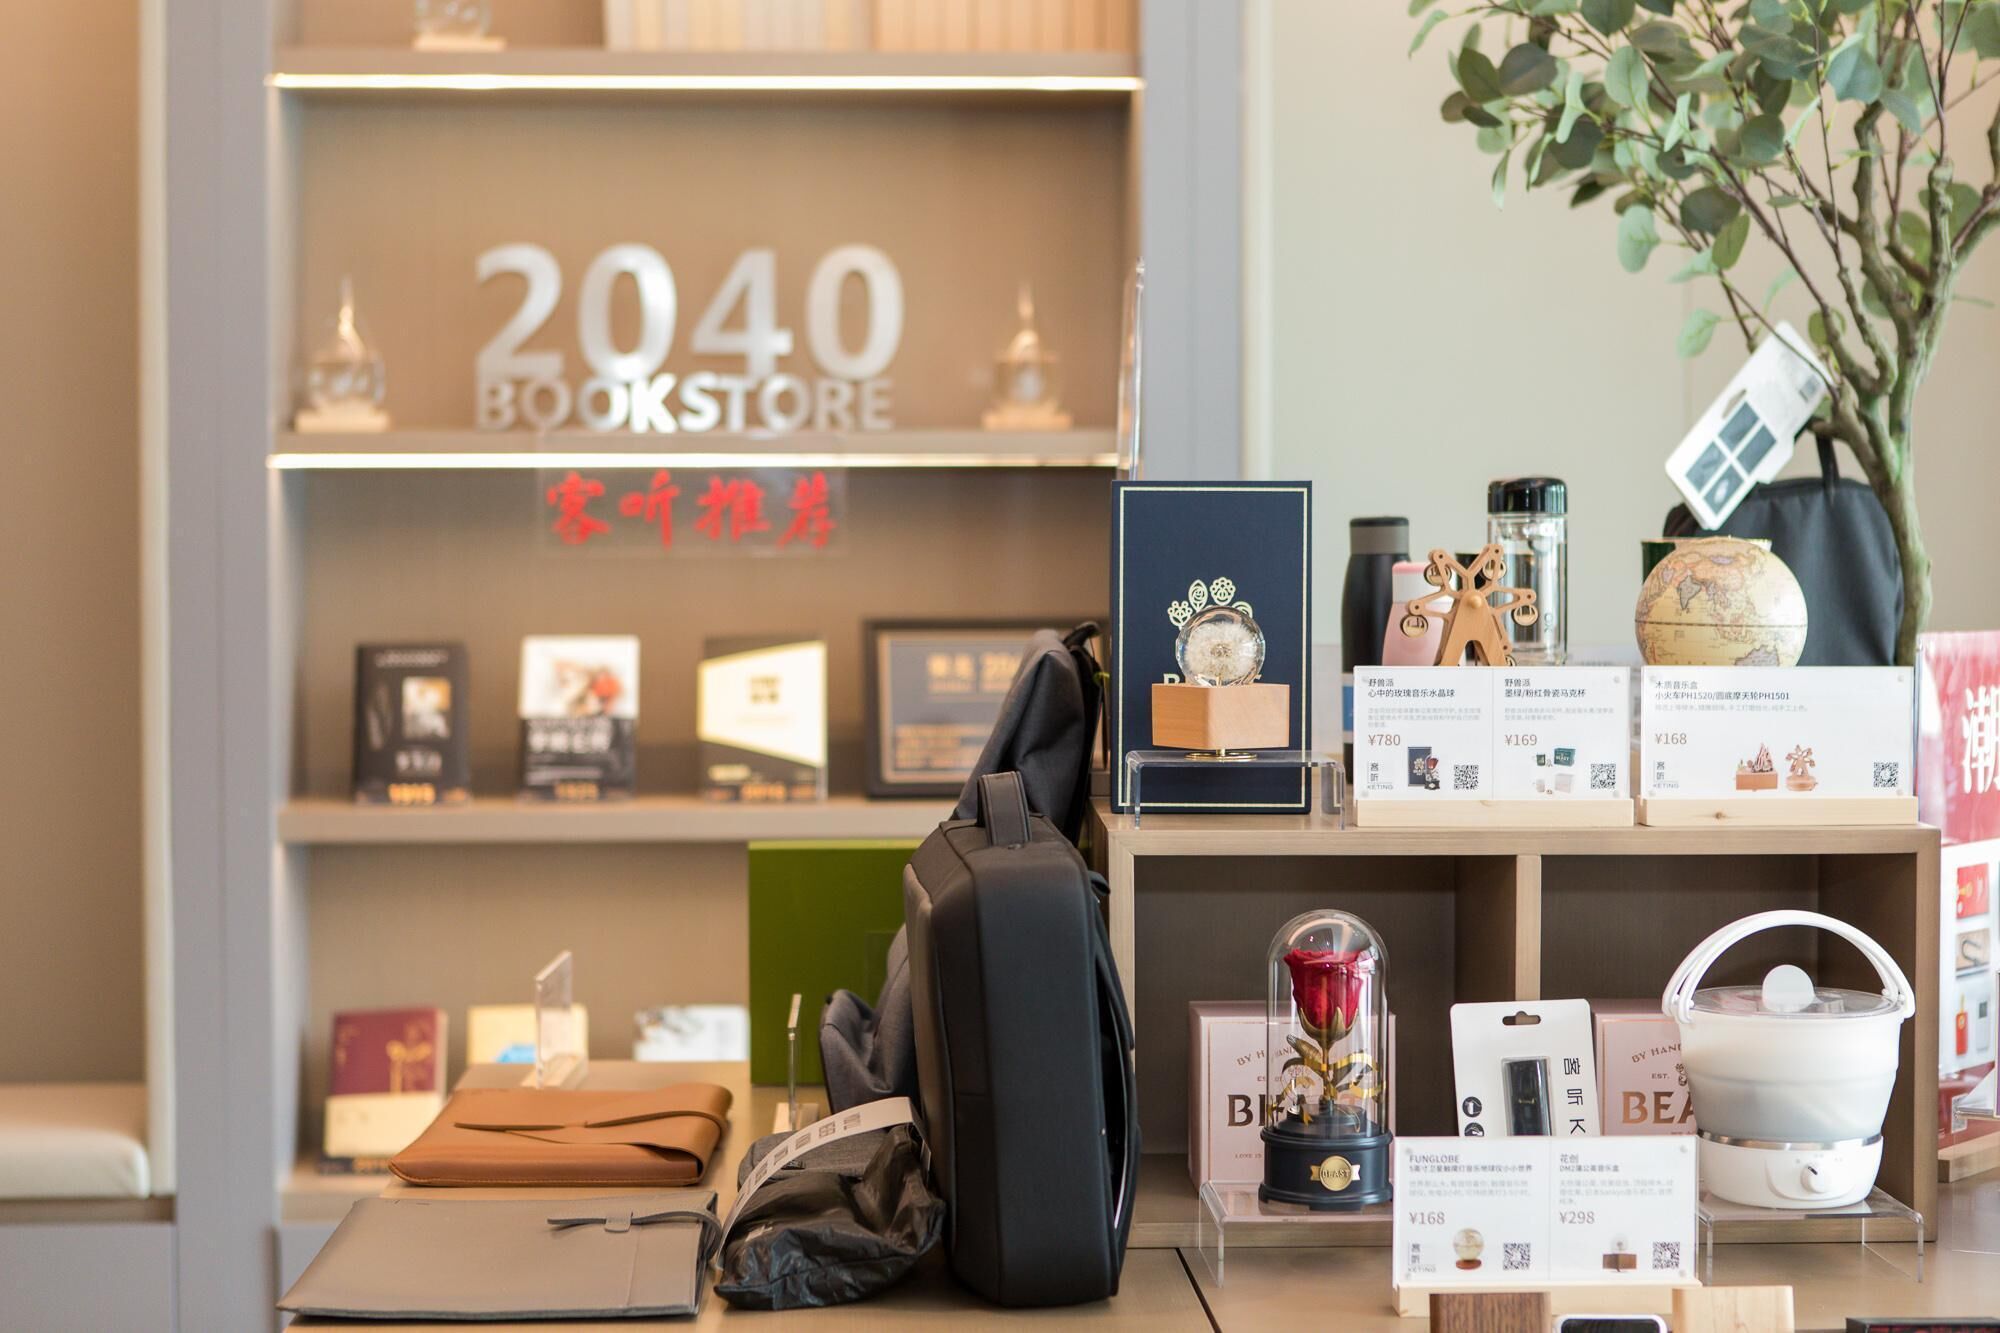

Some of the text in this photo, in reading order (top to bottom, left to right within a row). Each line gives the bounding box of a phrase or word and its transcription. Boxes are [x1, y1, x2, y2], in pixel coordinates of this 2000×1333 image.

[476, 243, 904, 379] 2040
[477, 373, 893, 433] BOOKSTORE
[546, 470, 837, 548] 客听推荐
[1368, 678, 1394, 687] 野兽派
[1504, 678, 1531, 687] 野兽派
[1655, 680, 1698, 690] 木质音乐盒
[1368, 688, 1456, 698] 心中的玫瑰音乐水晶球
[1368, 734, 1401, 746] ¥780
[1504, 734, 1537, 746] ¥169
[1655, 733, 1687, 745] ¥168
[1631, 1043, 1681, 1063] BY HAN
[1236, 1053, 1252, 1066] BY
[1409, 1154, 1460, 1163] FUNGLOBE
[1409, 1211, 1445, 1225] ¥168
[1559, 1211, 1595, 1225] ¥298
